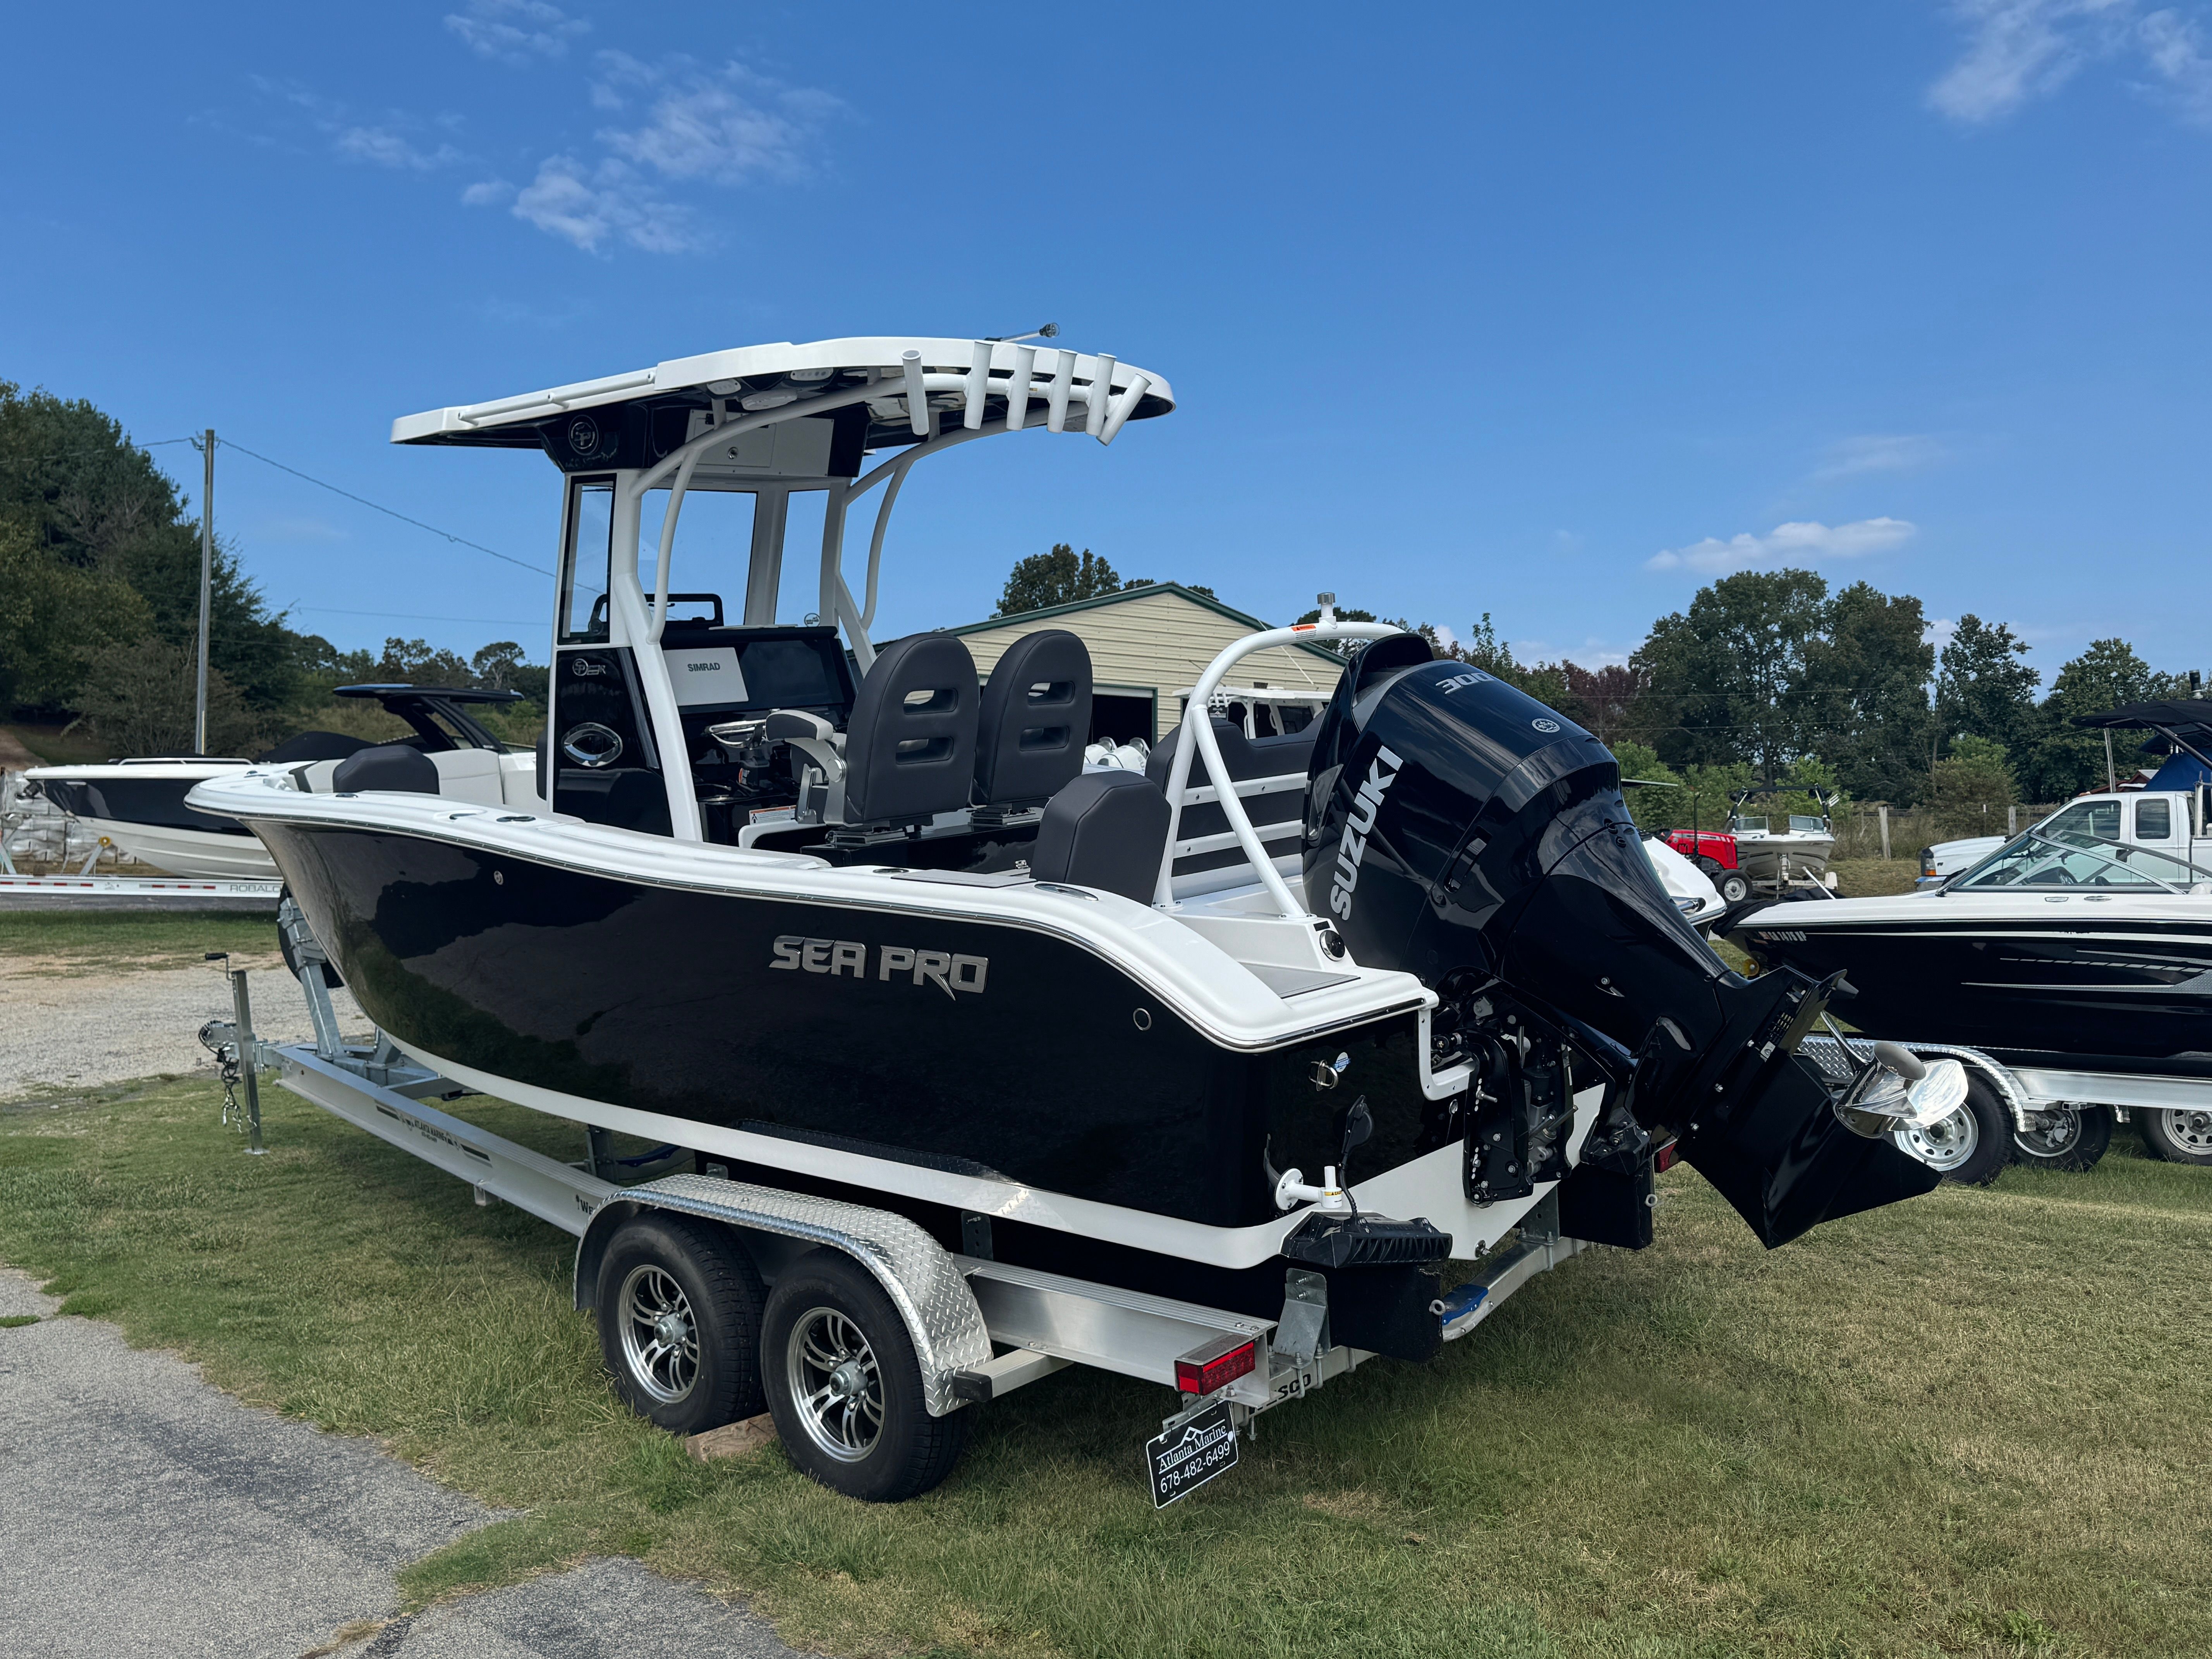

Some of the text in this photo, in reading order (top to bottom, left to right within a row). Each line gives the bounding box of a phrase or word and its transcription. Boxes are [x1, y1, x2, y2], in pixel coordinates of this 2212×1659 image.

[687, 663, 720, 672] SIMRAD
[1435, 673, 1496, 694] 300
[1330, 745, 1403, 921] SUZUKI
[230, 884, 280, 893] ROBALO
[769, 935, 989, 1001] SEA PRO
[1159, 1425, 1226, 1471] Atlanta Marine
[1160, 1441, 1230, 1493] 678-482-6499
